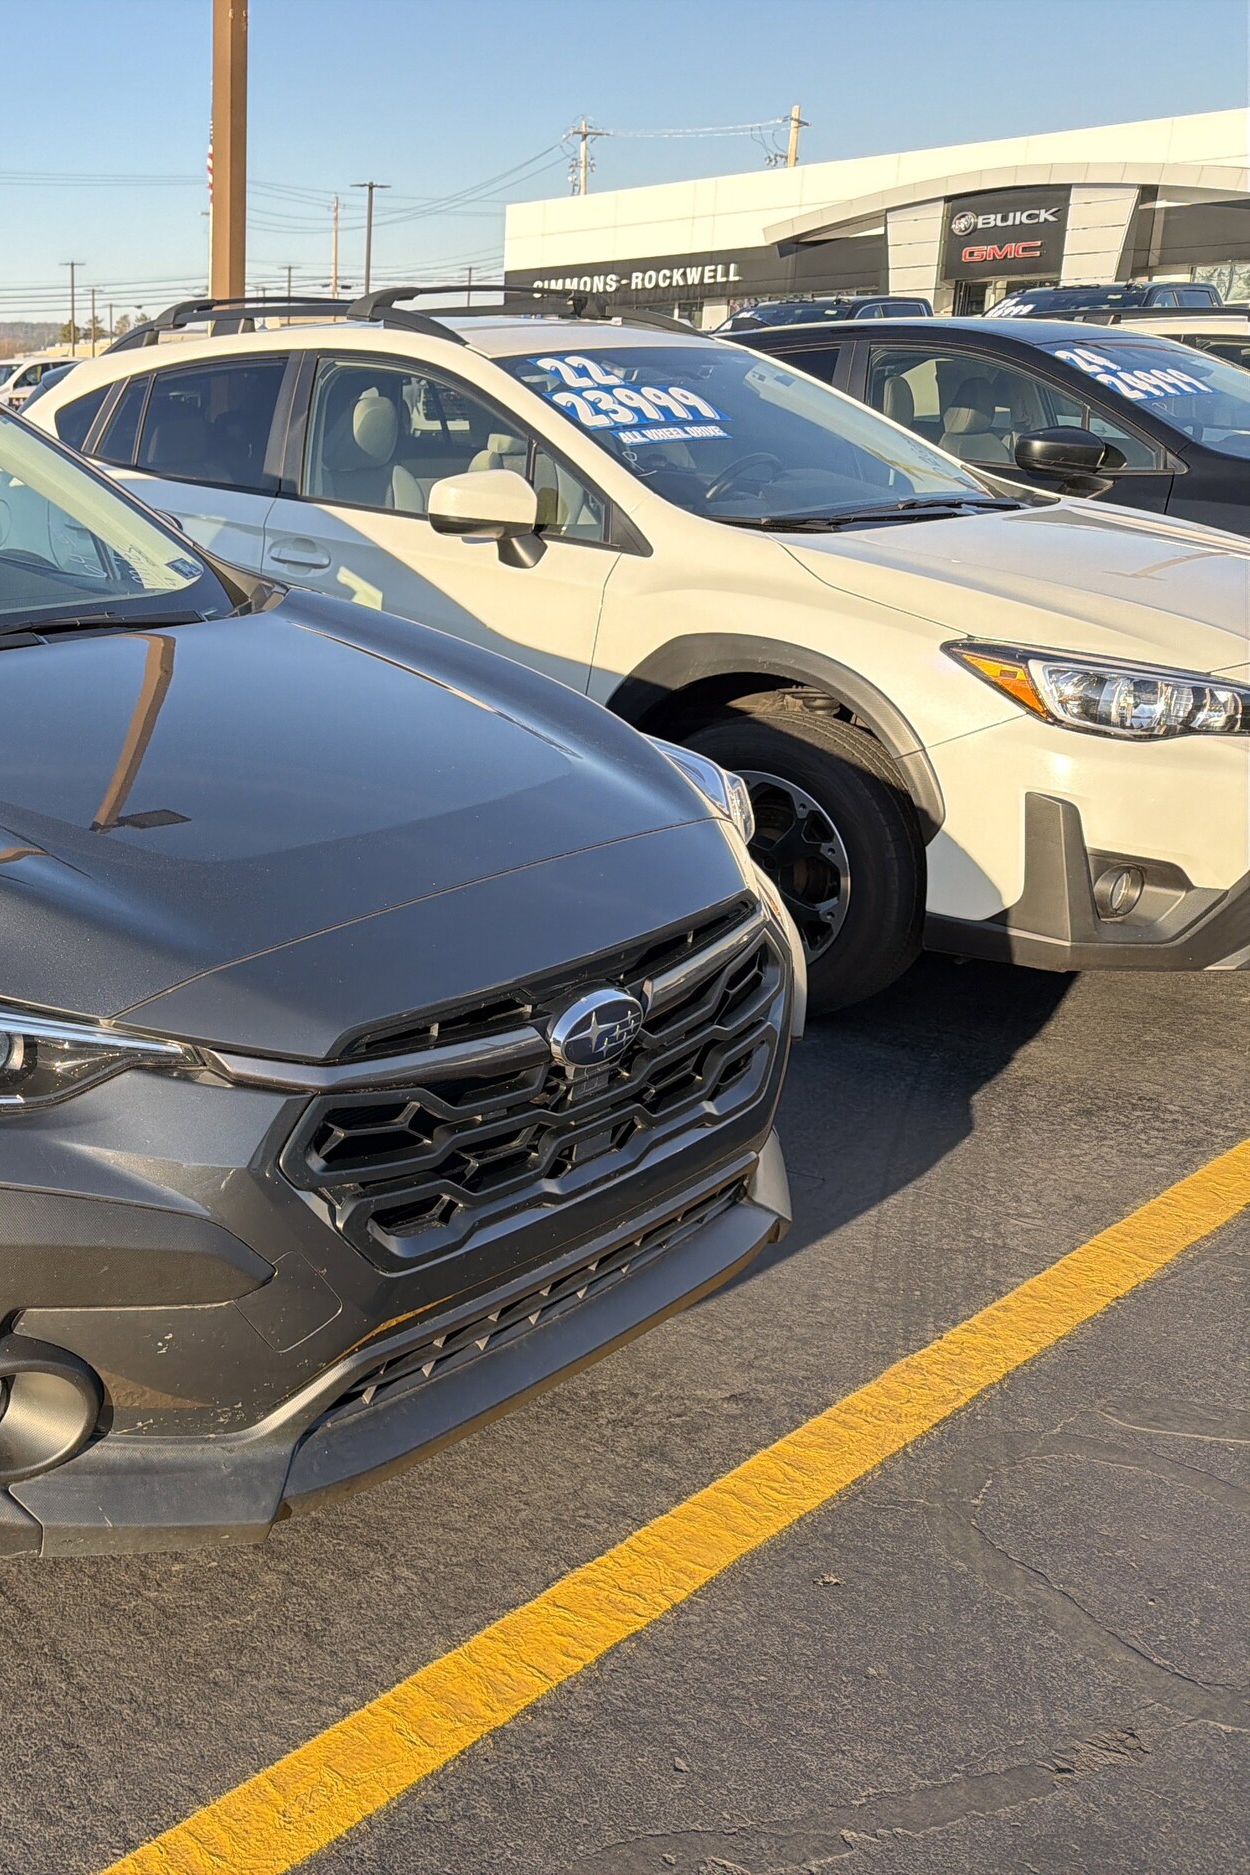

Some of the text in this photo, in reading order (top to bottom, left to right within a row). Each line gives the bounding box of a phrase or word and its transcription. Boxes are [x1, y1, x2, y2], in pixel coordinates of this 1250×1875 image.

[976, 207, 1061, 229] BUICK
[961, 240, 1042, 262] GMC
[536, 355, 625, 388] 22
[1054, 348, 1121, 373] 24
[1095, 368, 1214, 399] 24999
[552, 386, 721, 427] 23999
[618, 425, 728, 444] ALL WHEEL DRIVE
